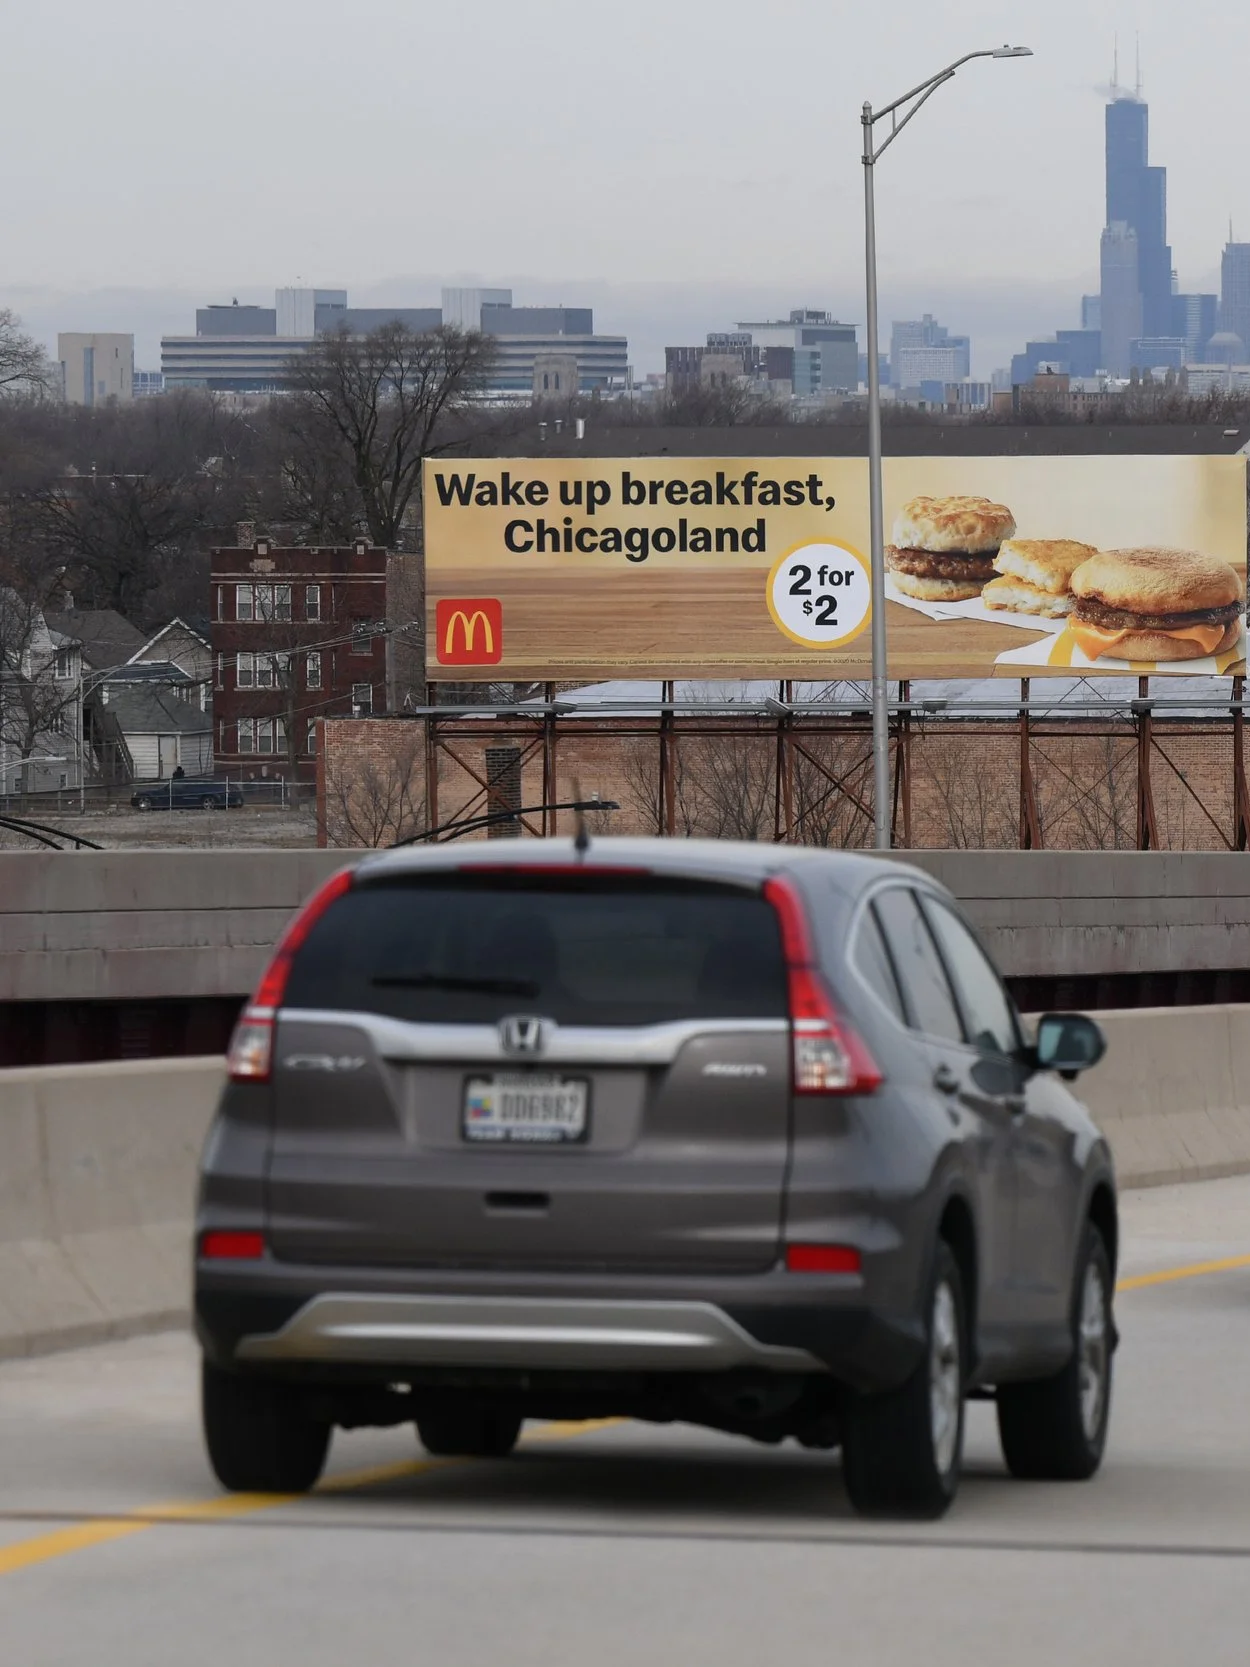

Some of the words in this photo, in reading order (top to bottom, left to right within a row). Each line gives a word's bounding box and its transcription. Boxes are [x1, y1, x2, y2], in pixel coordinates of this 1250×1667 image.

[434, 472, 549, 506] Wake
[559, 479, 612, 515] up
[621, 471, 836, 512] breakfast,
[503, 517, 767, 562] Chicagoland
[788, 564, 812, 596] 2
[817, 565, 855, 587] for
[802, 594, 838, 626] $2
